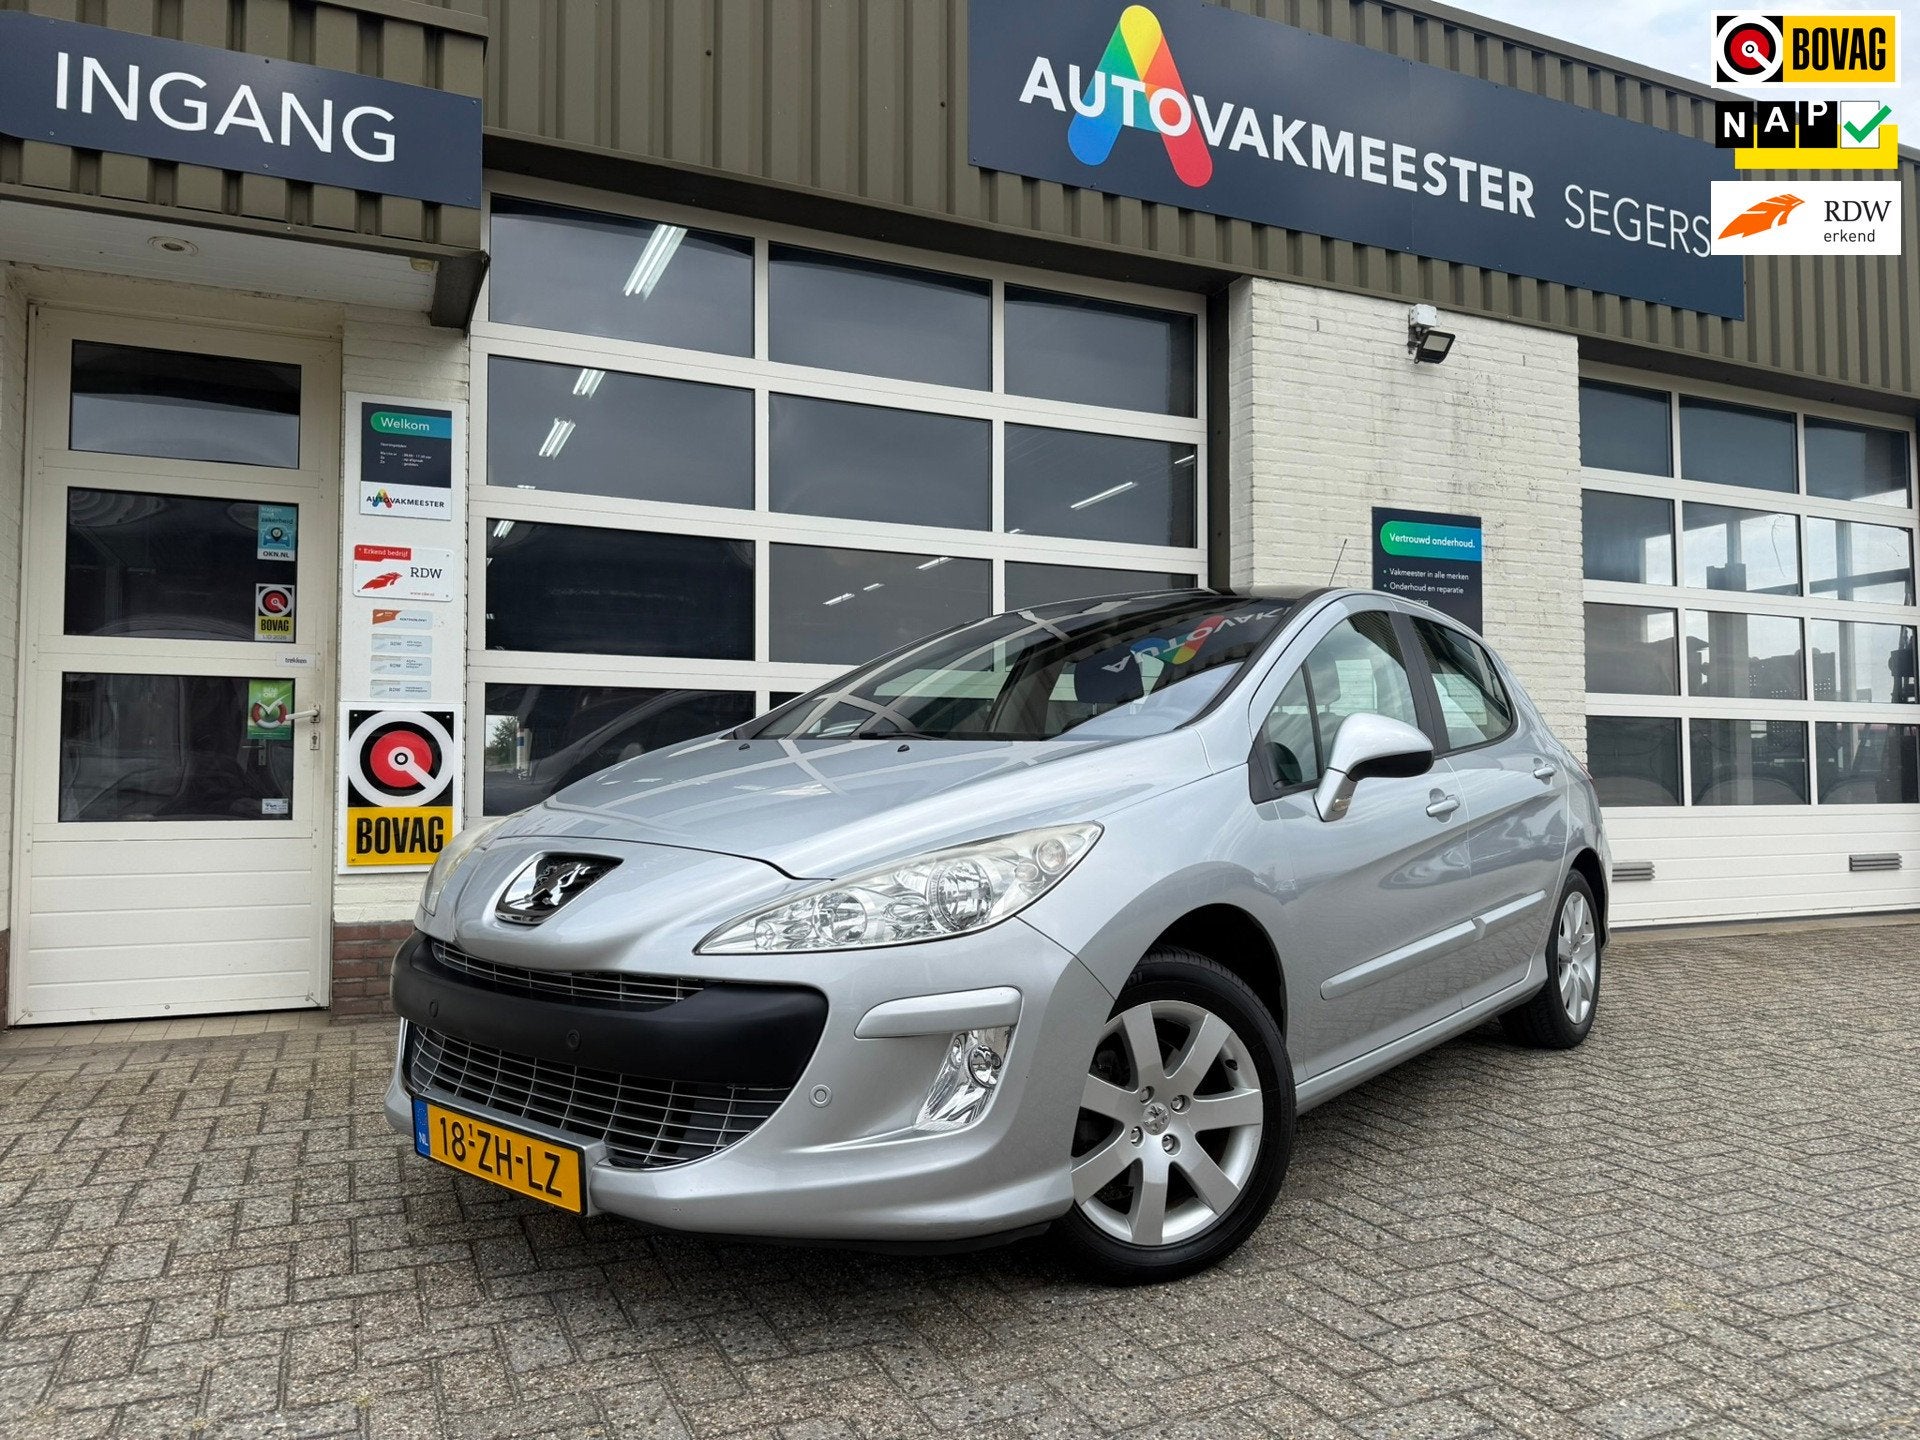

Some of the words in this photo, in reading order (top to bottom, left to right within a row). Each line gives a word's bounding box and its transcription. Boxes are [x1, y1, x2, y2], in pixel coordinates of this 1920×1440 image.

[56, 52, 396, 163] INGANG
[1019, 56, 1536, 219] AUTOVAKMEESTER
[1564, 185, 1711, 258] SEGERS
[380, 417, 430, 431] Welkom
[366, 495, 445, 508] AUTOVAKMEESTER
[1389, 533, 1431, 545] Vertrouwd
[1432, 536, 1475, 548] onderhoud.
[363, 548, 386, 556] Erkend
[387, 549, 408, 558] bedrijf
[410, 567, 443, 579] RDW
[1389, 568, 1426, 578] Vakmeester
[1434, 570, 1445, 579] alle
[1446, 572, 1469, 581] merken
[1389, 581, 1427, 592] Onderhoud
[1436, 586, 1464, 595] reparatie
[261, 619, 289, 631] BOVAG
[356, 816, 444, 855] BOVAG
[418, 1132, 429, 1147] NL
[440, 1117, 563, 1198] 18-ZH-LZ
